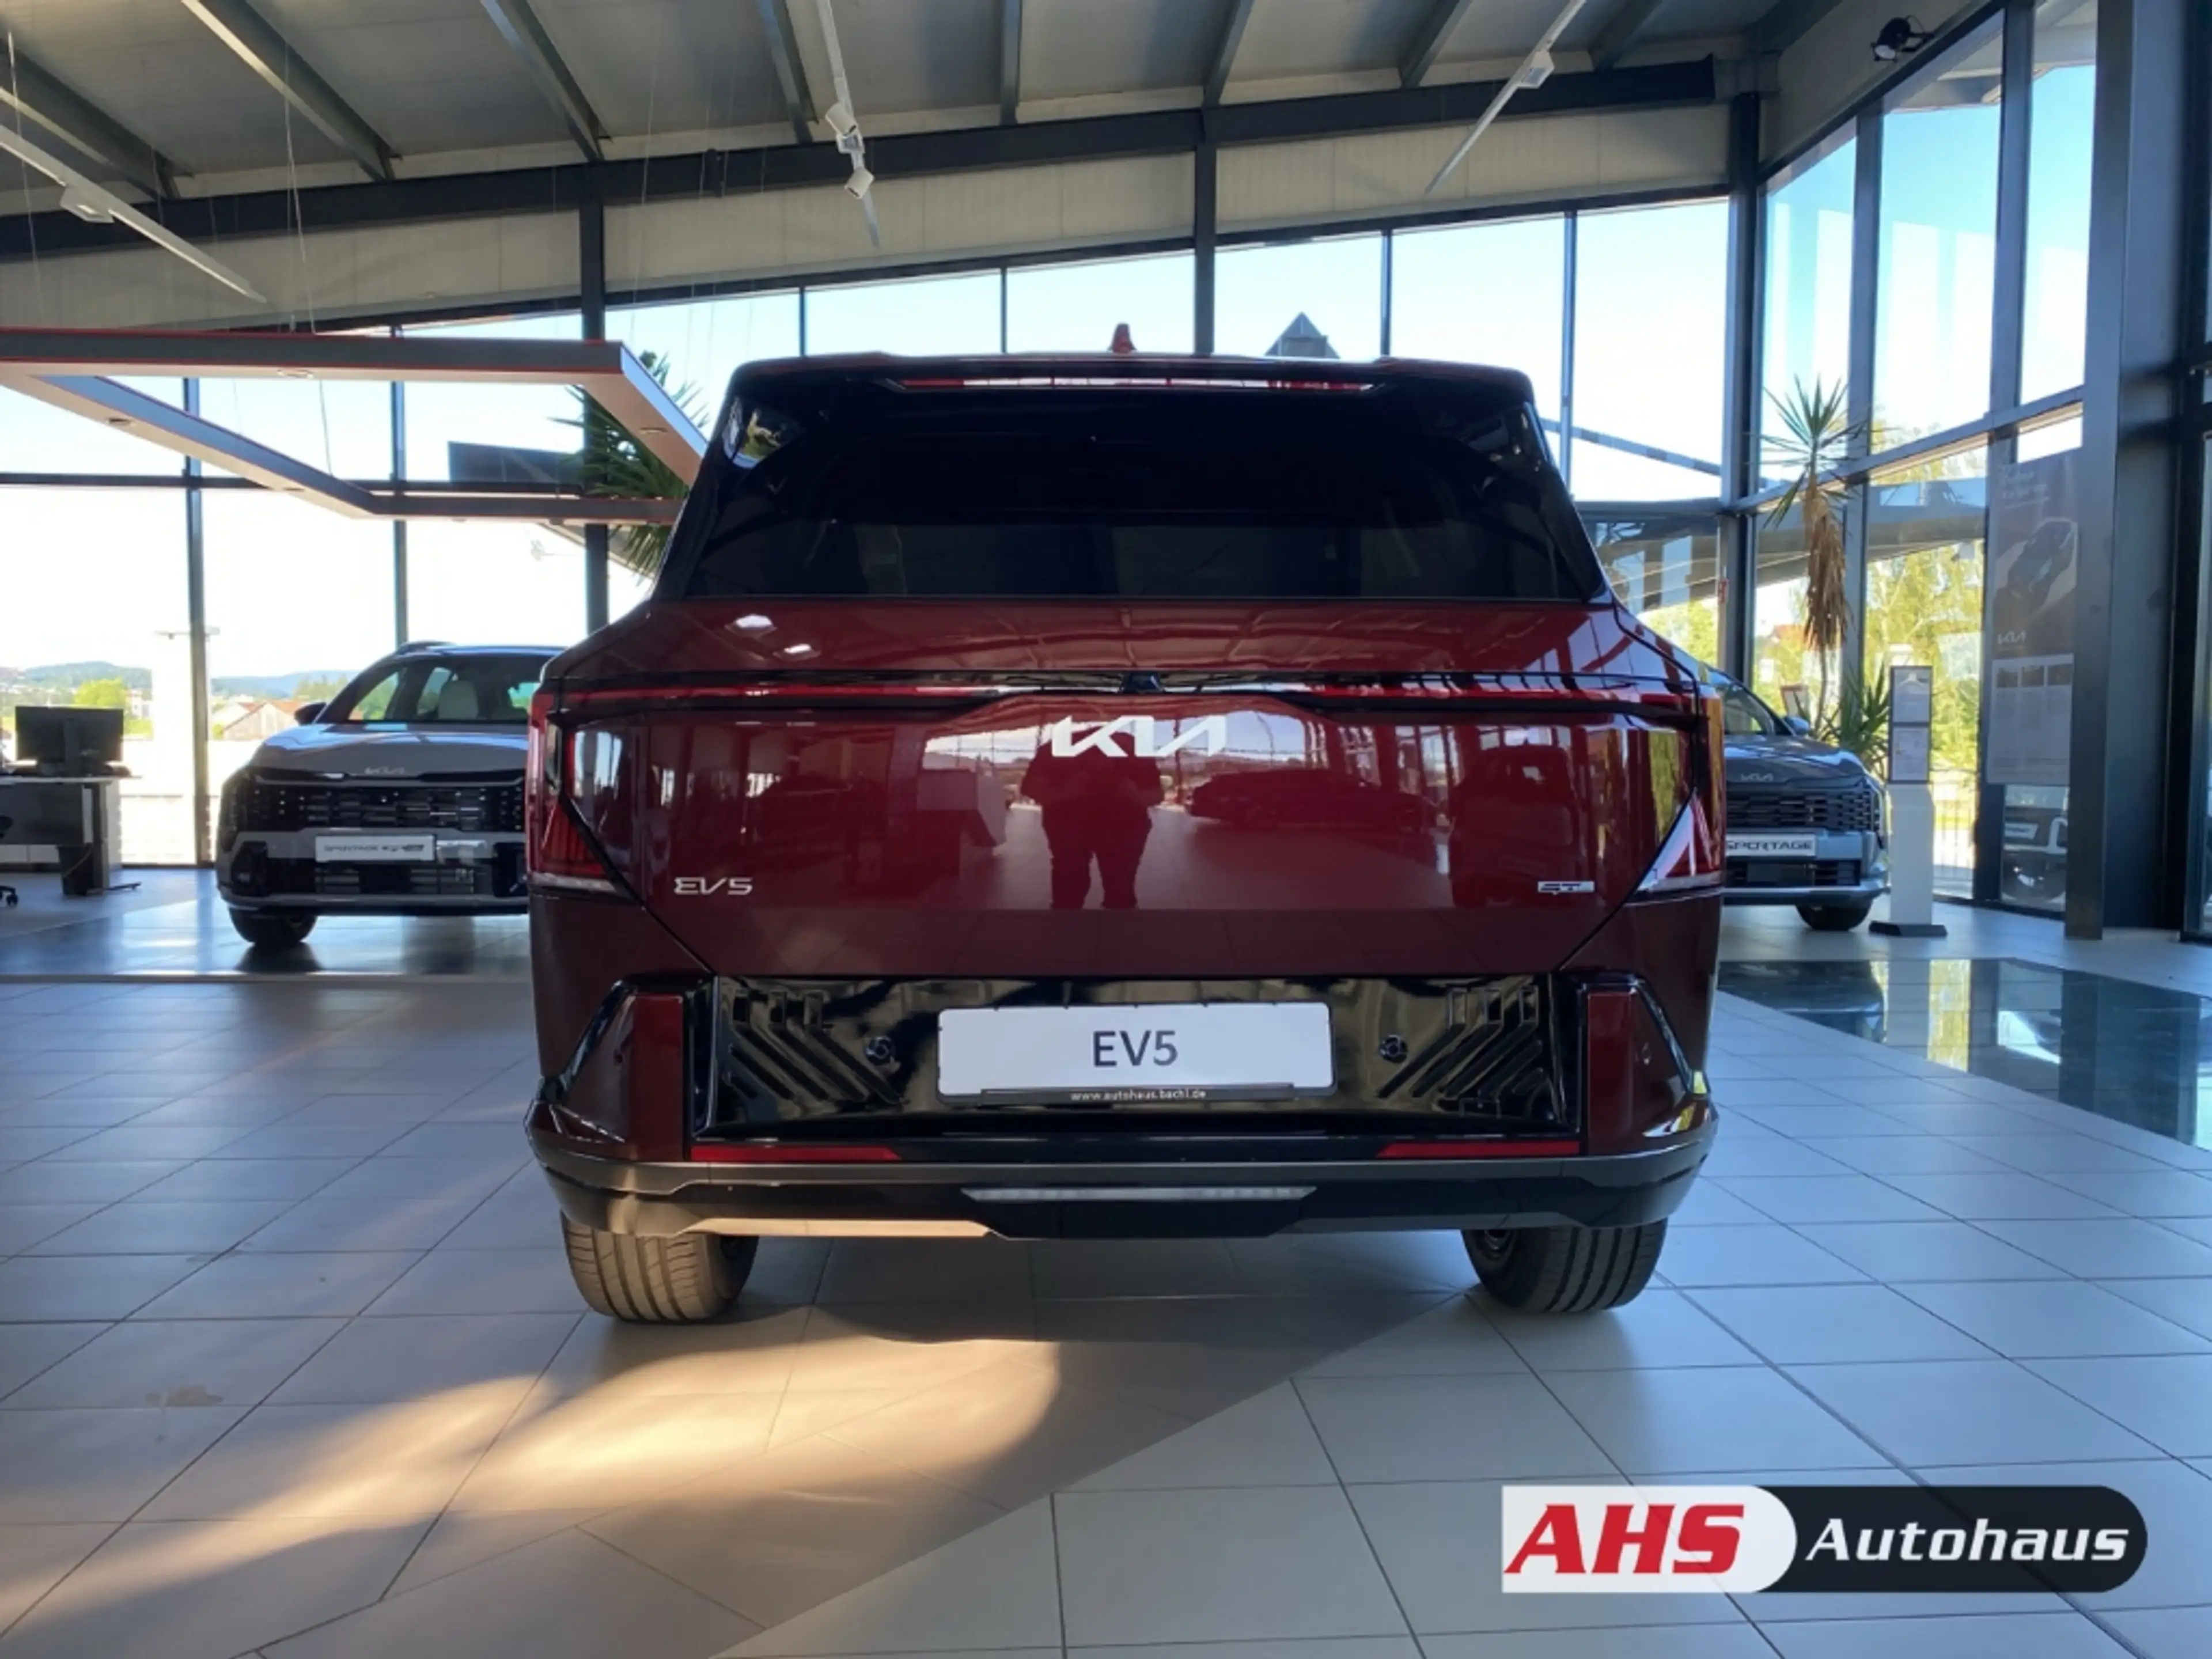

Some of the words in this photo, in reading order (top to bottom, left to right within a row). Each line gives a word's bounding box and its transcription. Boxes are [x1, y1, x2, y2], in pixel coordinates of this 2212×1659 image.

[1052, 715, 1226, 757] KIA
[673, 876, 753, 895] EV5
[1093, 1030, 1178, 1067] EV5
